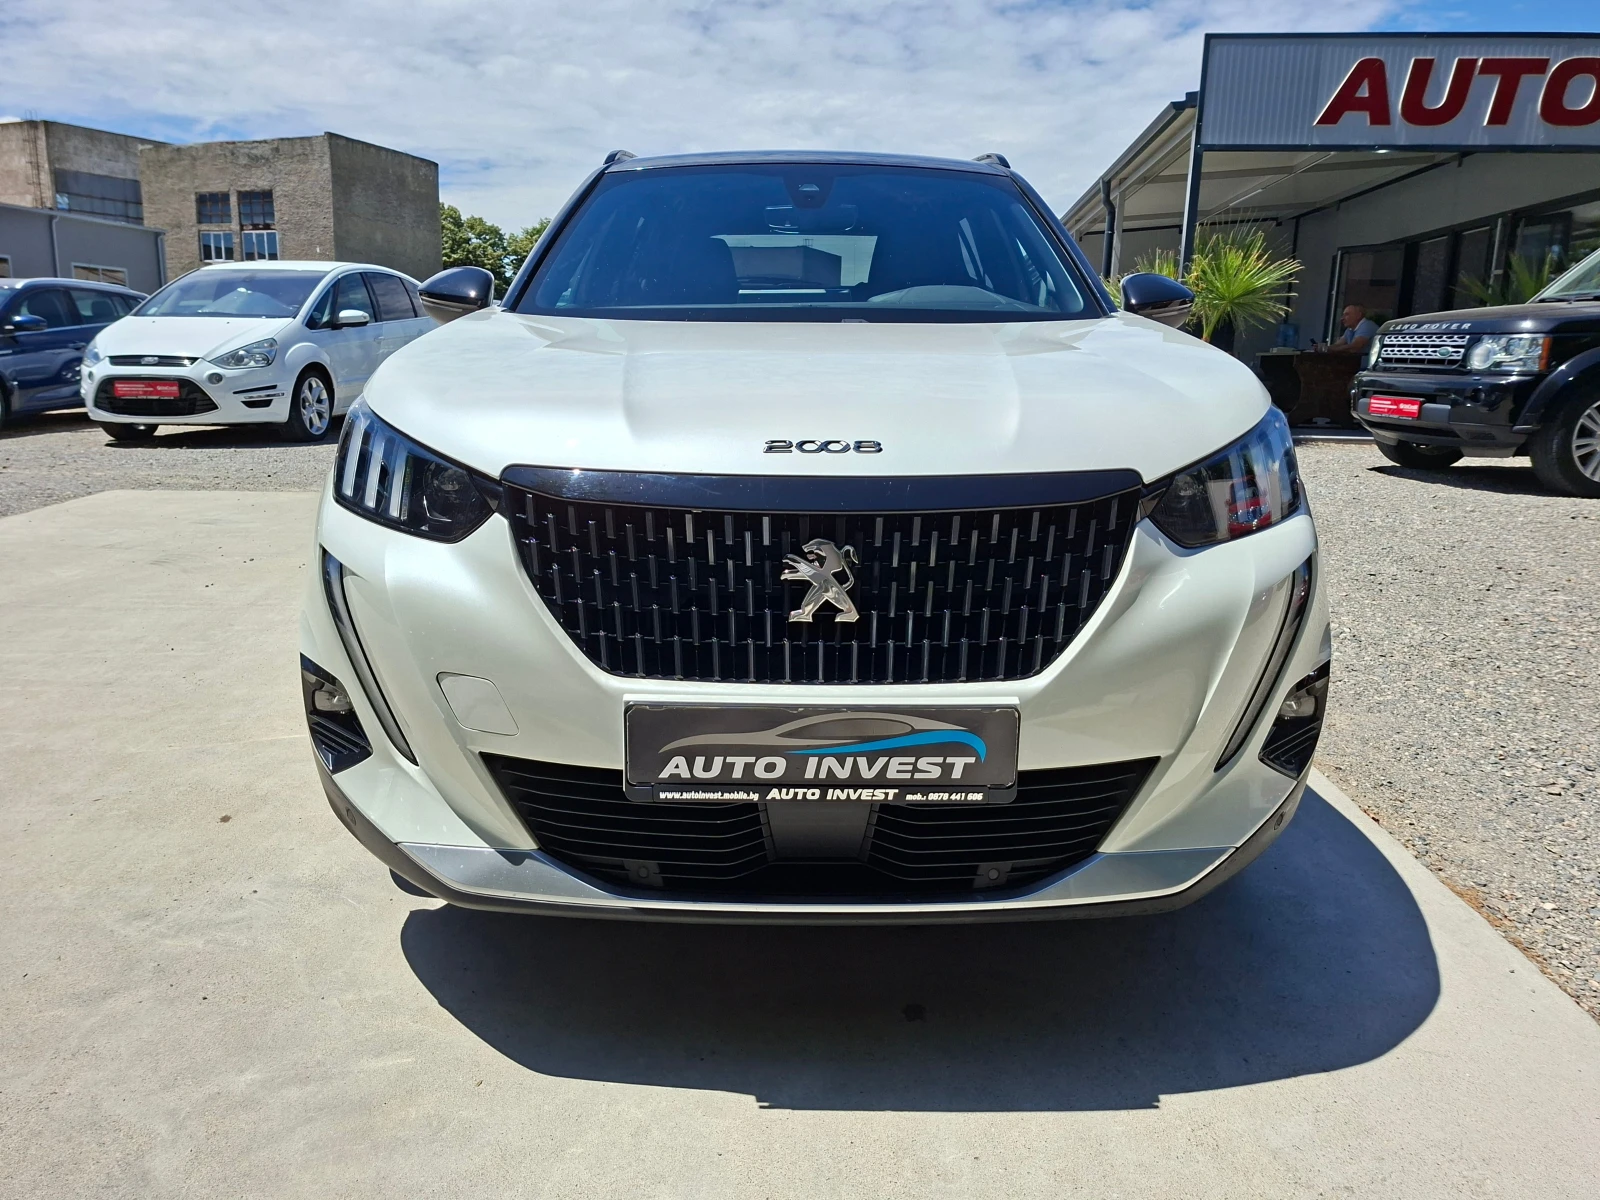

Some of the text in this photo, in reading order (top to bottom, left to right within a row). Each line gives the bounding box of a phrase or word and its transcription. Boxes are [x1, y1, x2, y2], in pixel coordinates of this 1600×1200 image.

[1312, 57, 1600, 127] AUTO
[1389, 322, 1472, 331] LAND ROVER
[763, 440, 883, 454] 2008
[658, 756, 976, 779] AUTO INVEST
[659, 791, 760, 801] www.autoinvest.mobile.bg
[766, 788, 899, 800] AUTO INVEST
[928, 792, 949, 801] 0878
[950, 792, 965, 801] 441
[967, 792, 983, 801] 606
